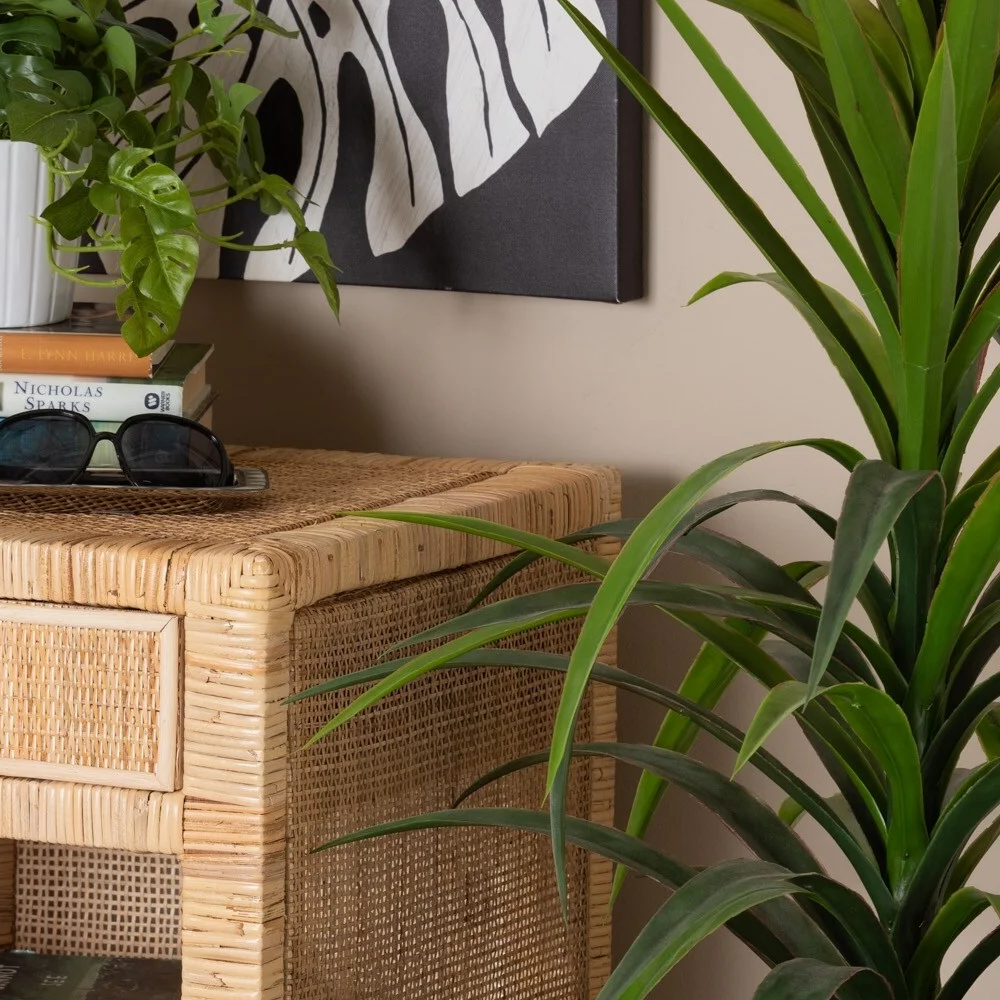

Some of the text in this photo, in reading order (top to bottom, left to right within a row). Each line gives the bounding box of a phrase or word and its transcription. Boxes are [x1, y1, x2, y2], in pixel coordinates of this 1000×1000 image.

[38, 349, 78, 361] LYNN
[84, 350, 133, 363] HARRI
[13, 380, 103, 398] NICHOLAS
[24, 397, 91, 413] SPARKS
